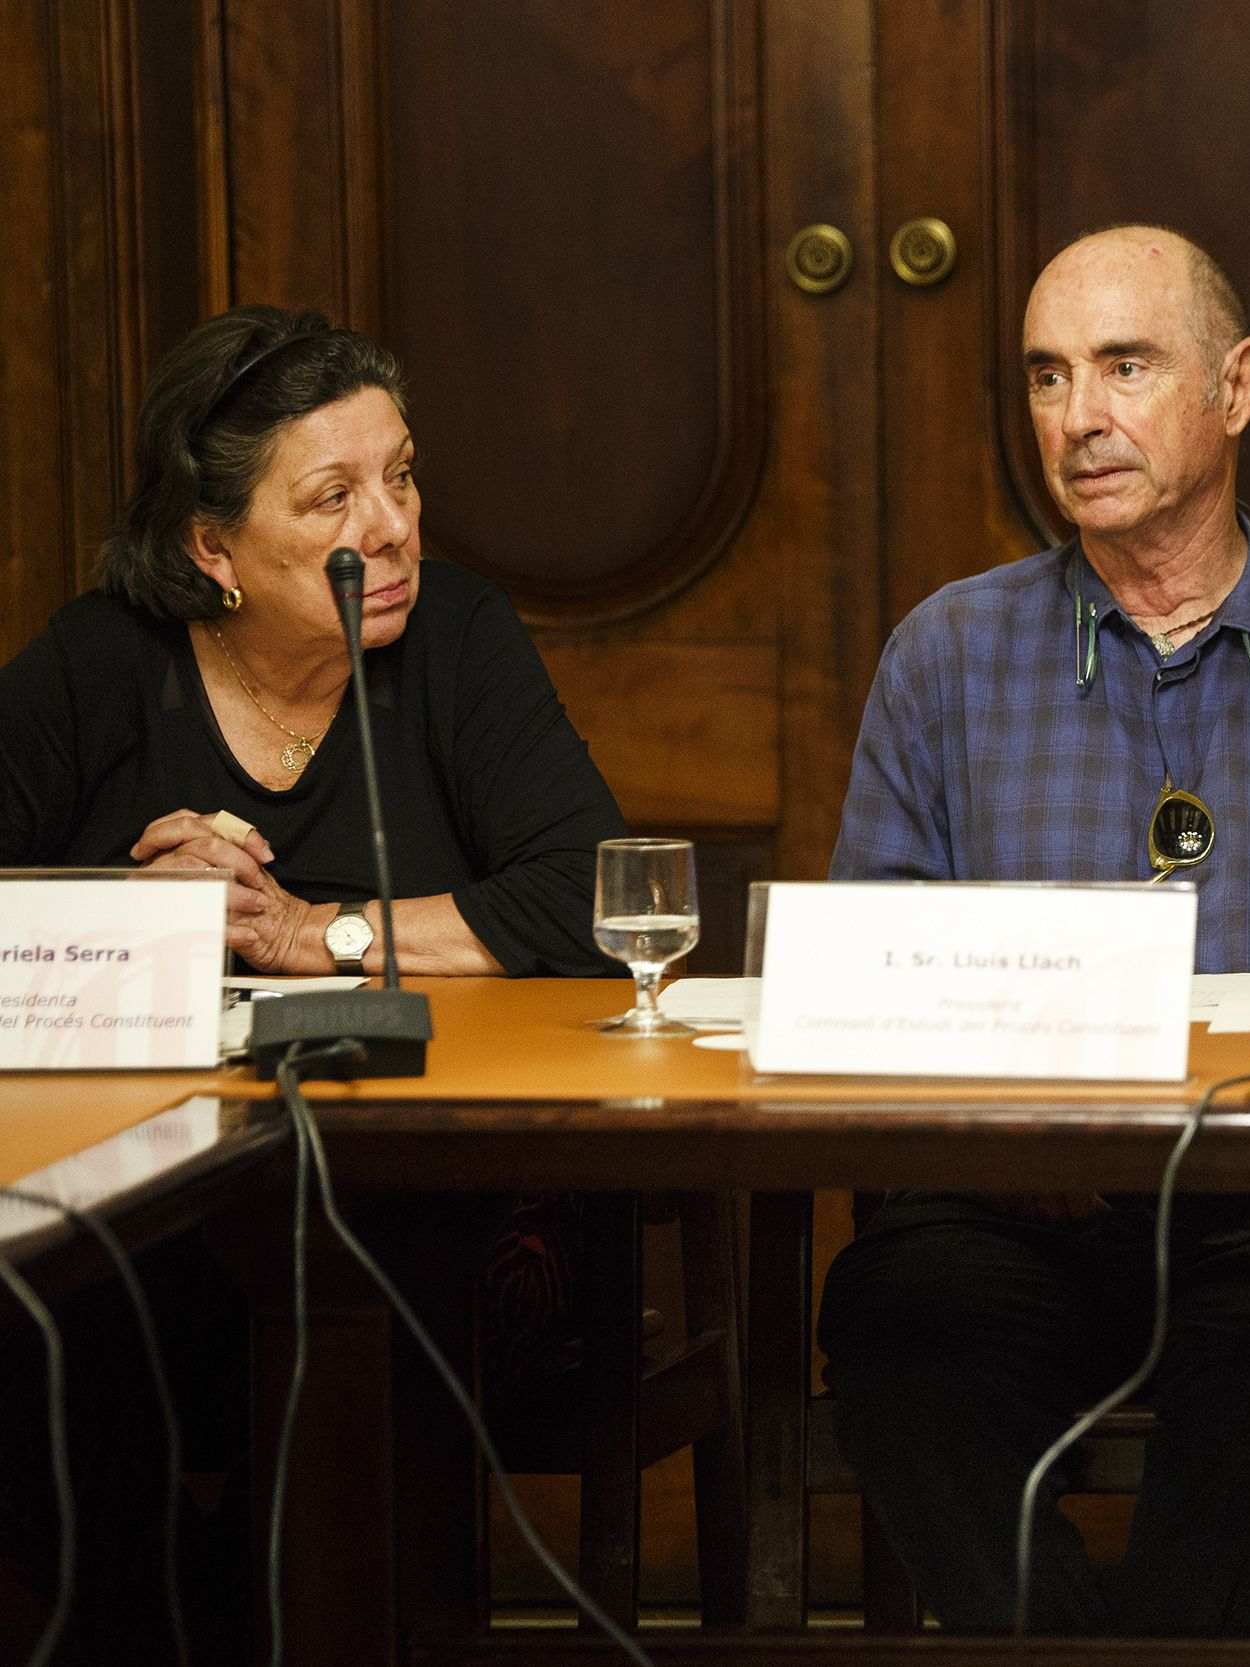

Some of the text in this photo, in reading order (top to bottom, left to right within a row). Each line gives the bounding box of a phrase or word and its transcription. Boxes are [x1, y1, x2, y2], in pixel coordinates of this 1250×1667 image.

[0, 945, 131, 963] riela Serra
[1018, 952, 1082, 970] Llach
[0, 993, 78, 1008] esidenta
[24, 1012, 84, 1029] Procés
[90, 1014, 193, 1029] Constituent
